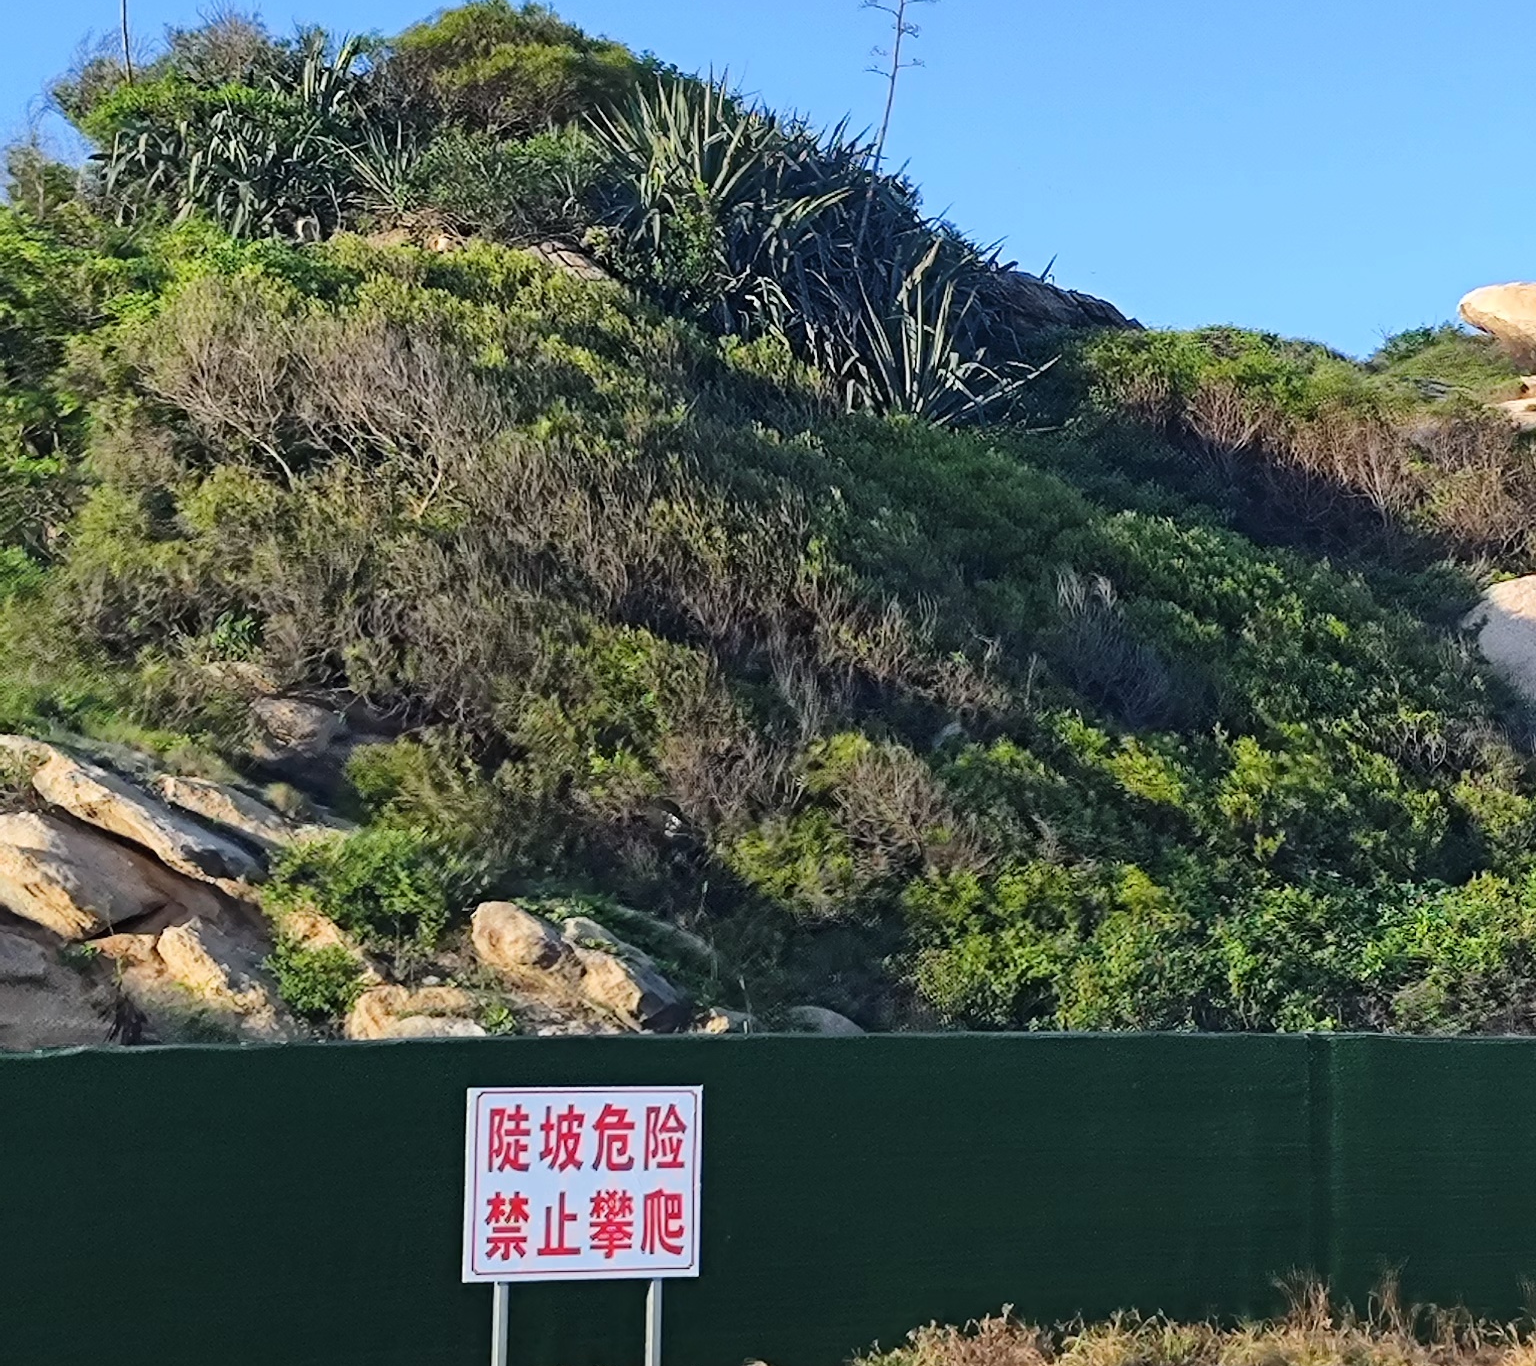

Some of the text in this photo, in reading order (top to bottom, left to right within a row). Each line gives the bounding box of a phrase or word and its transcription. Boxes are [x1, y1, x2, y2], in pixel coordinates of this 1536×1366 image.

[487, 1103, 687, 1173] 陡坡危险
[485, 1188, 686, 1261] 禁止攀爬
